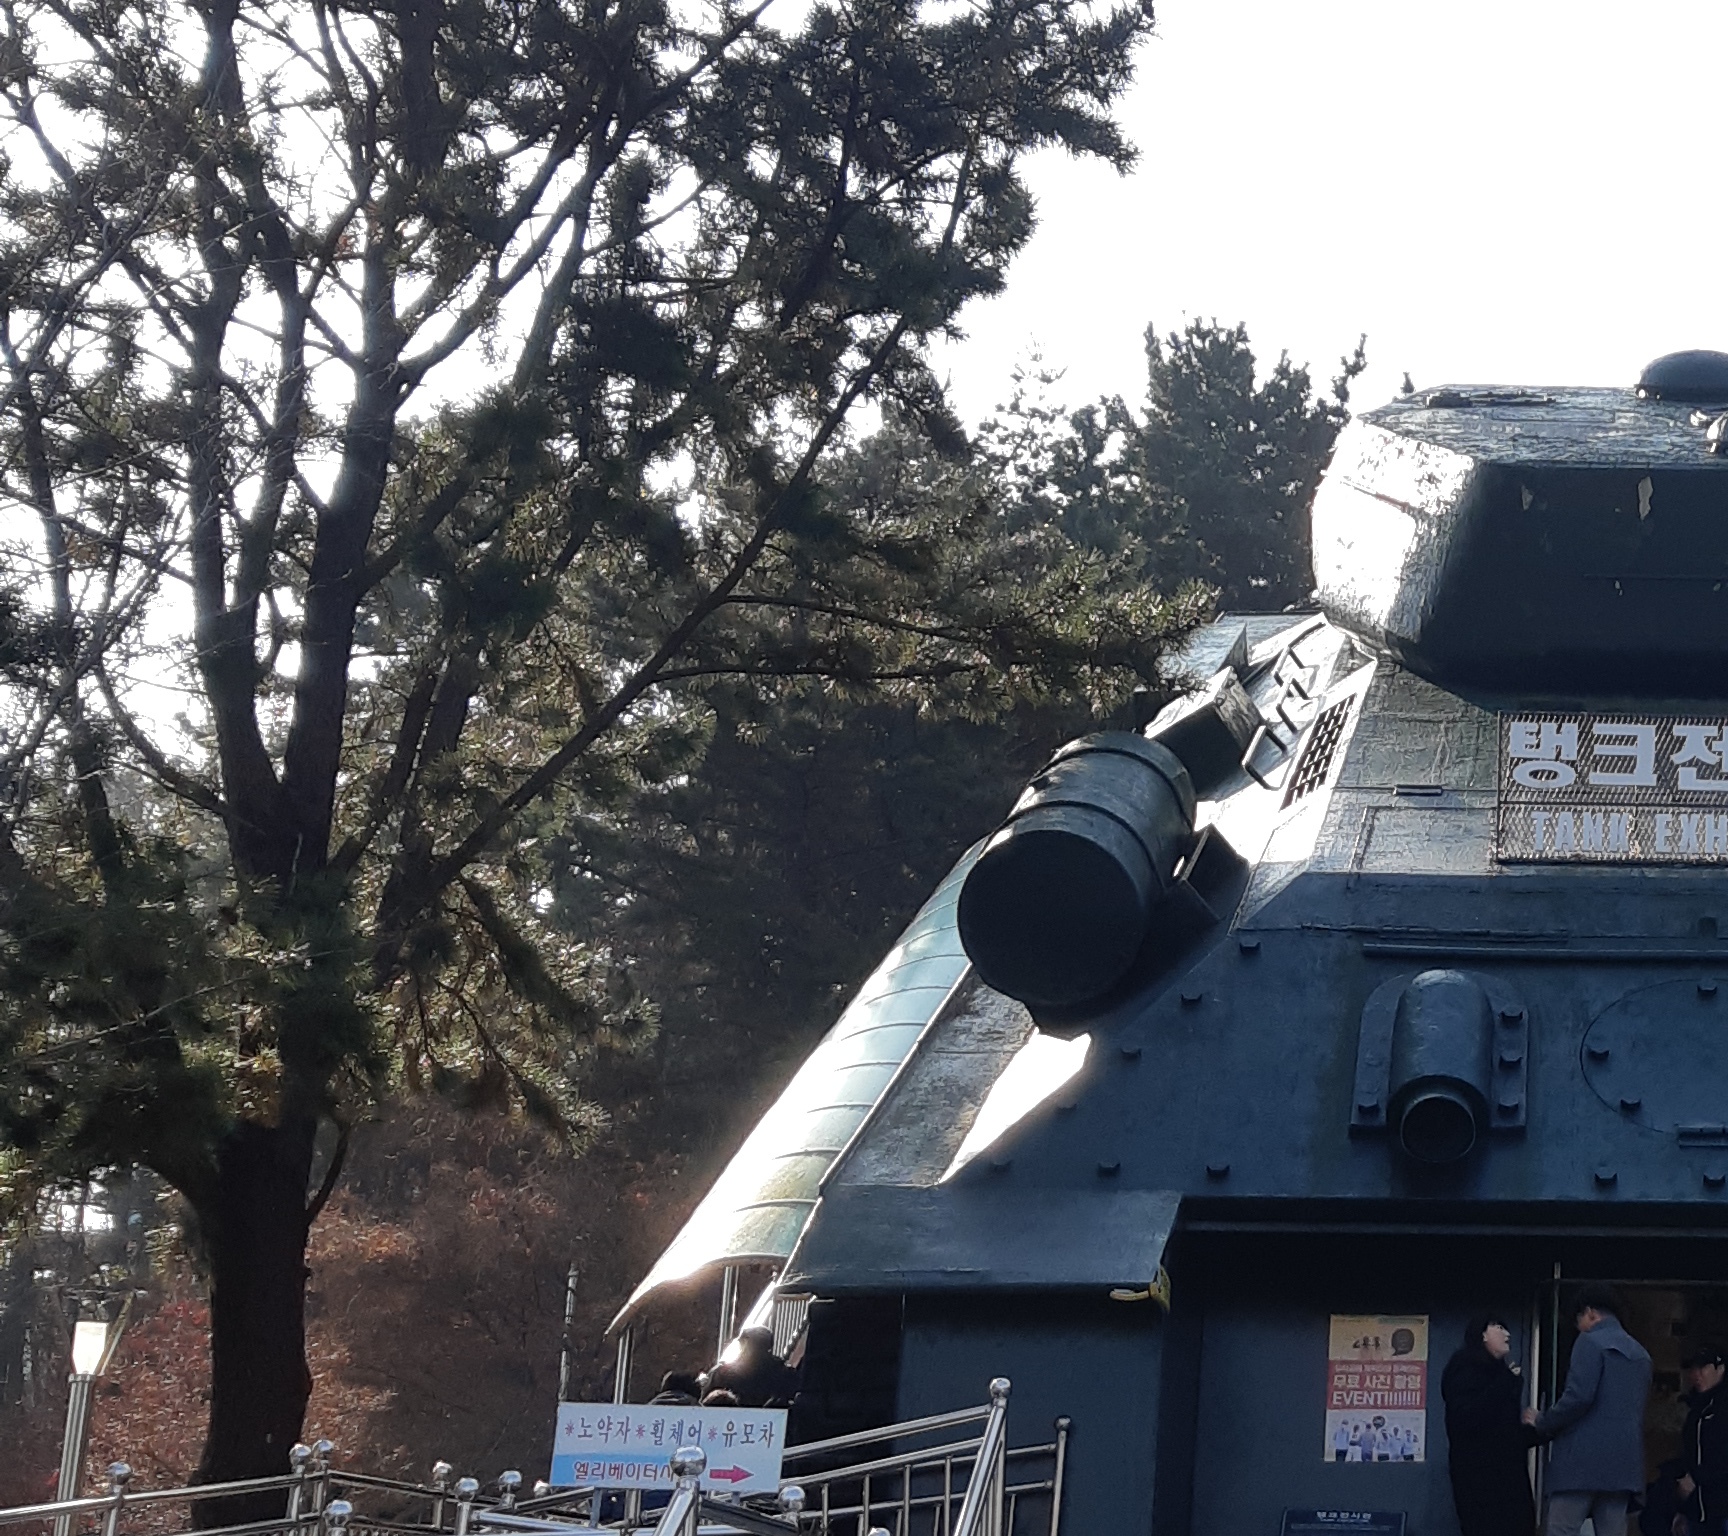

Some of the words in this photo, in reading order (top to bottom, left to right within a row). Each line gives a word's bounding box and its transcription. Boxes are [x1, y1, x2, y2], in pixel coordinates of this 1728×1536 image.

[1531, 811, 1630, 853] TANK
[1363, 1375, 1390, 1389] 사진
[577, 1416, 631, 1445] 노약자
[650, 1419, 703, 1447] 휠체어
[721, 1420, 775, 1448] 유모차
